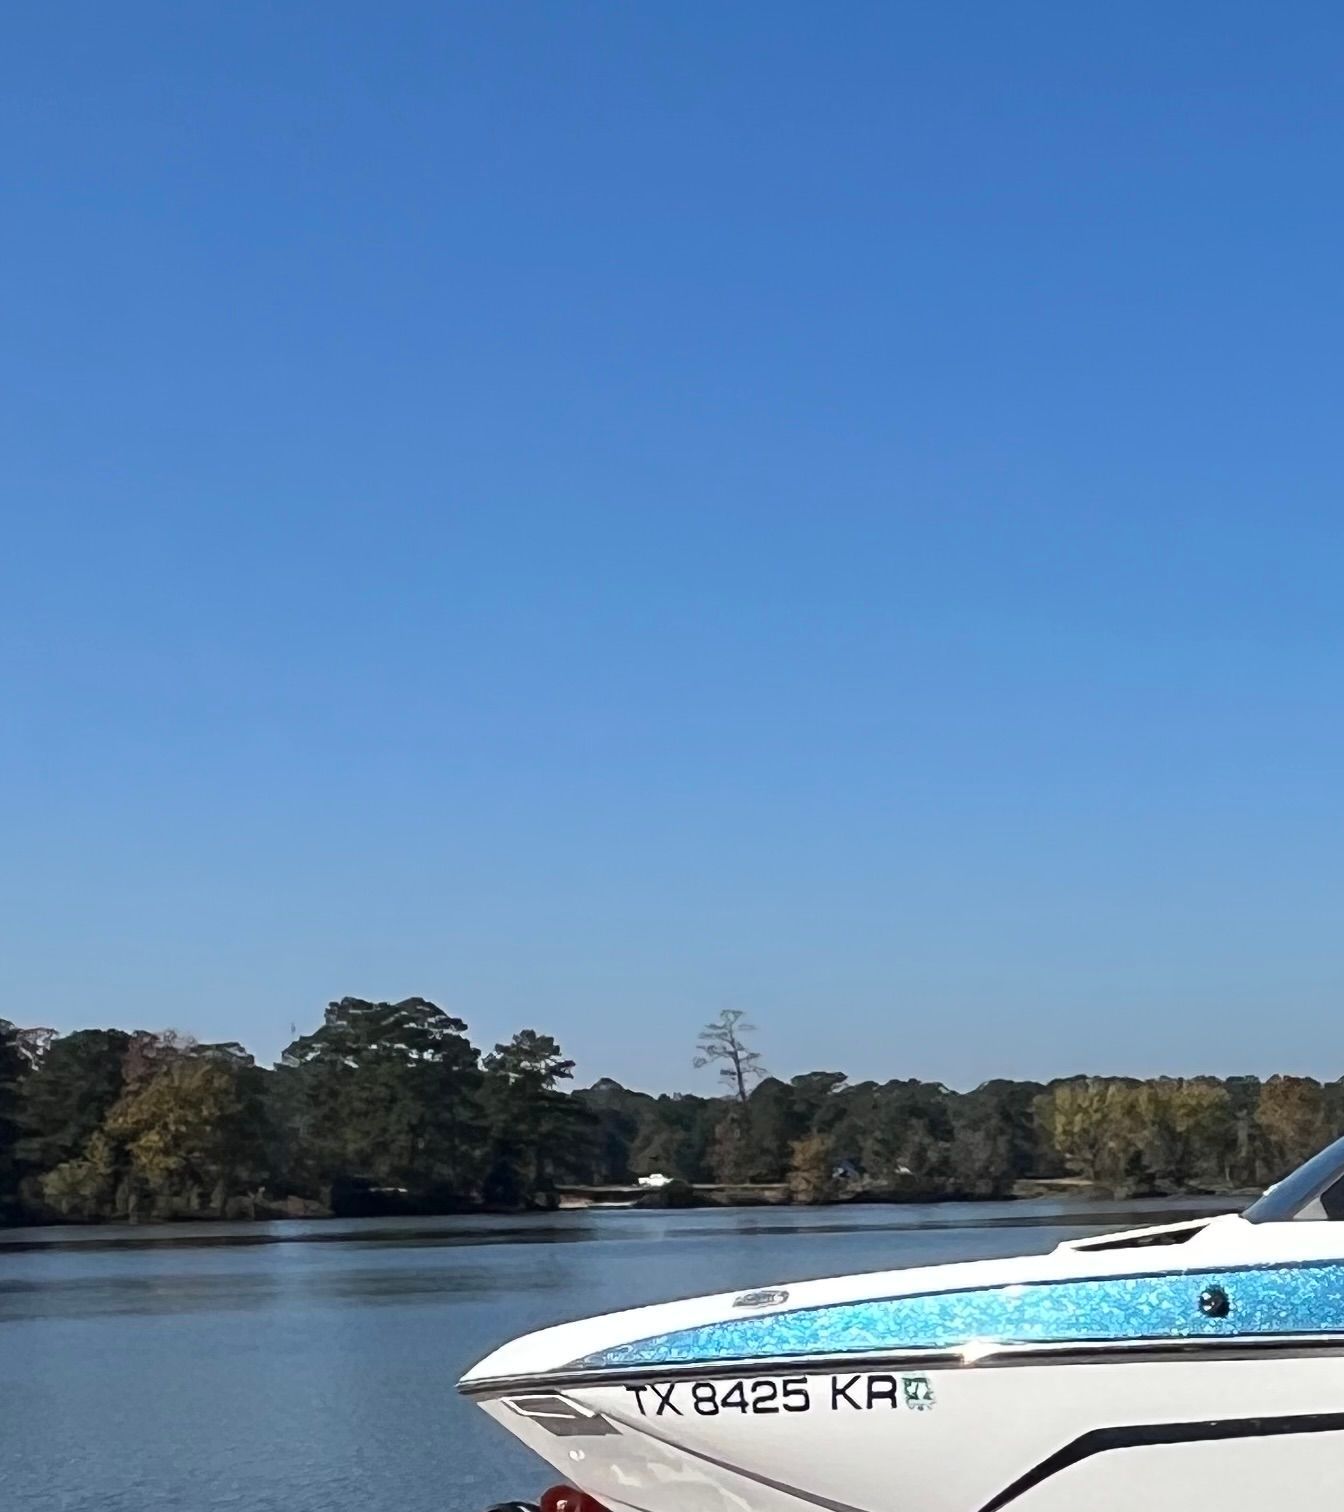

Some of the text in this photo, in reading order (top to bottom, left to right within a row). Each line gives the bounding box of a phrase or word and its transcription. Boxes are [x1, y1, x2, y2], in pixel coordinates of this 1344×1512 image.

[625, 1382, 684, 1416] TX
[692, 1376, 810, 1416] 8425
[831, 1374, 898, 1411] KR
